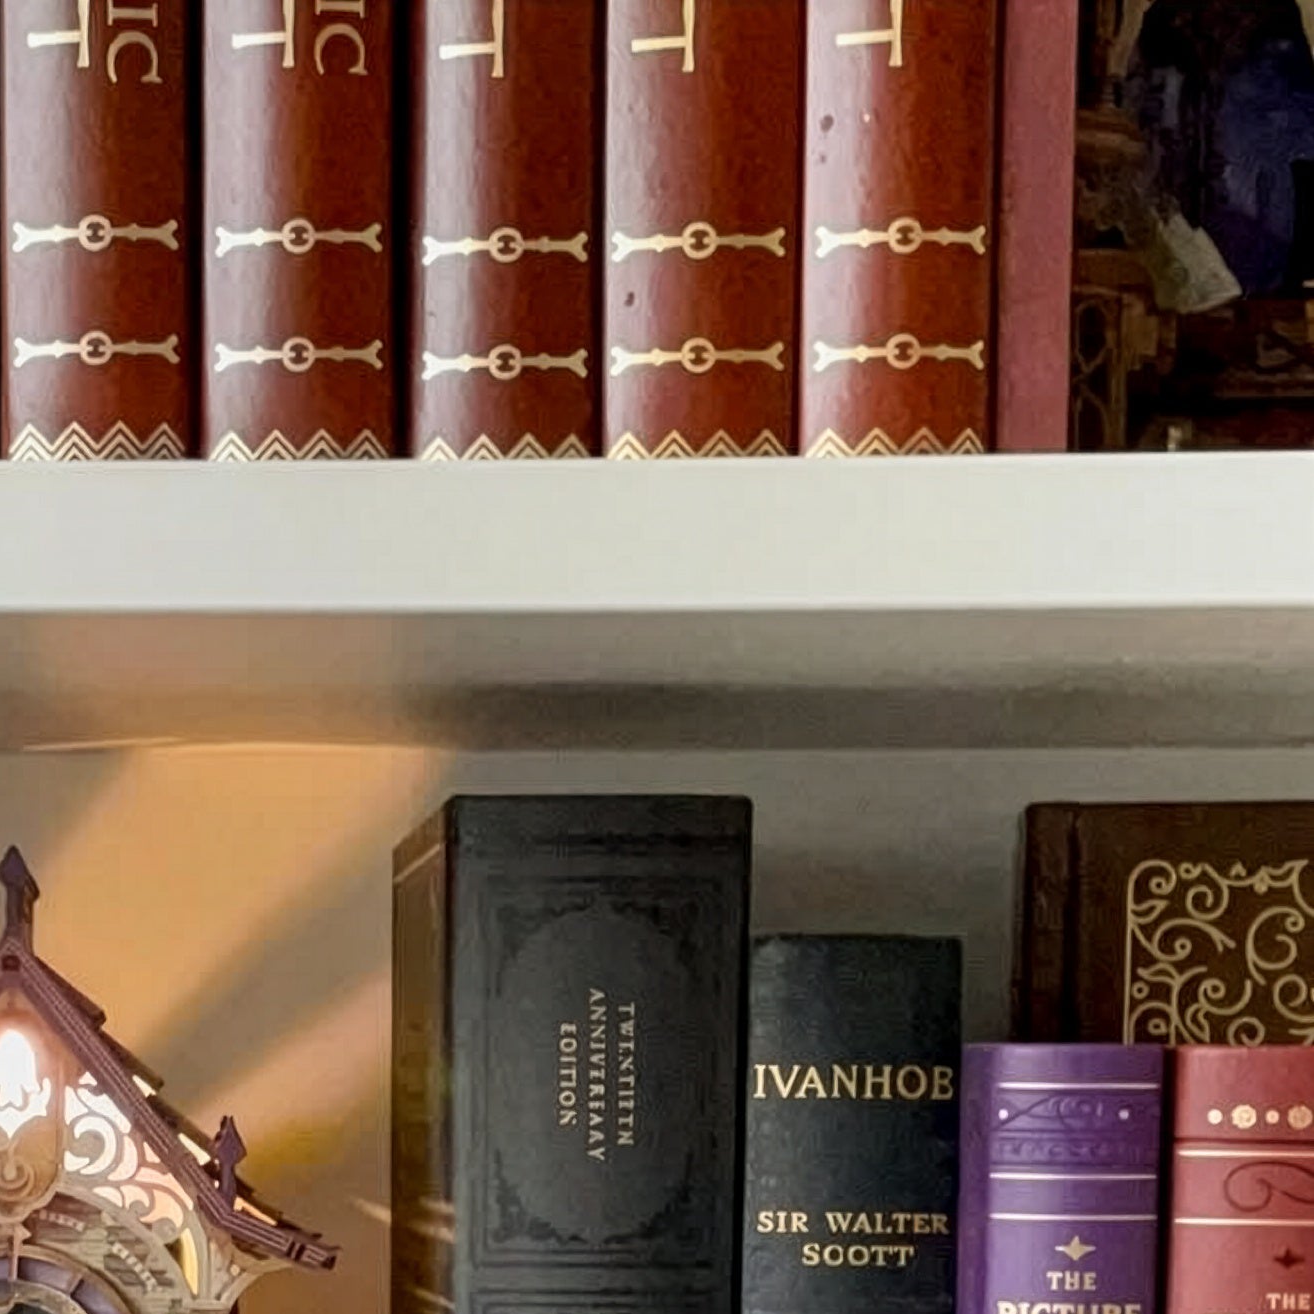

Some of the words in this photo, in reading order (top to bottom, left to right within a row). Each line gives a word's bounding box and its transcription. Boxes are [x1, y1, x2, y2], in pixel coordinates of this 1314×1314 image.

[757, 1210, 809, 1234] SIR
[825, 1211, 950, 1235] WALTER
[802, 1243, 915, 1267] SCOTT
[1046, 1271, 1097, 1291] THE
[1266, 1292, 1311, 1310] THE
